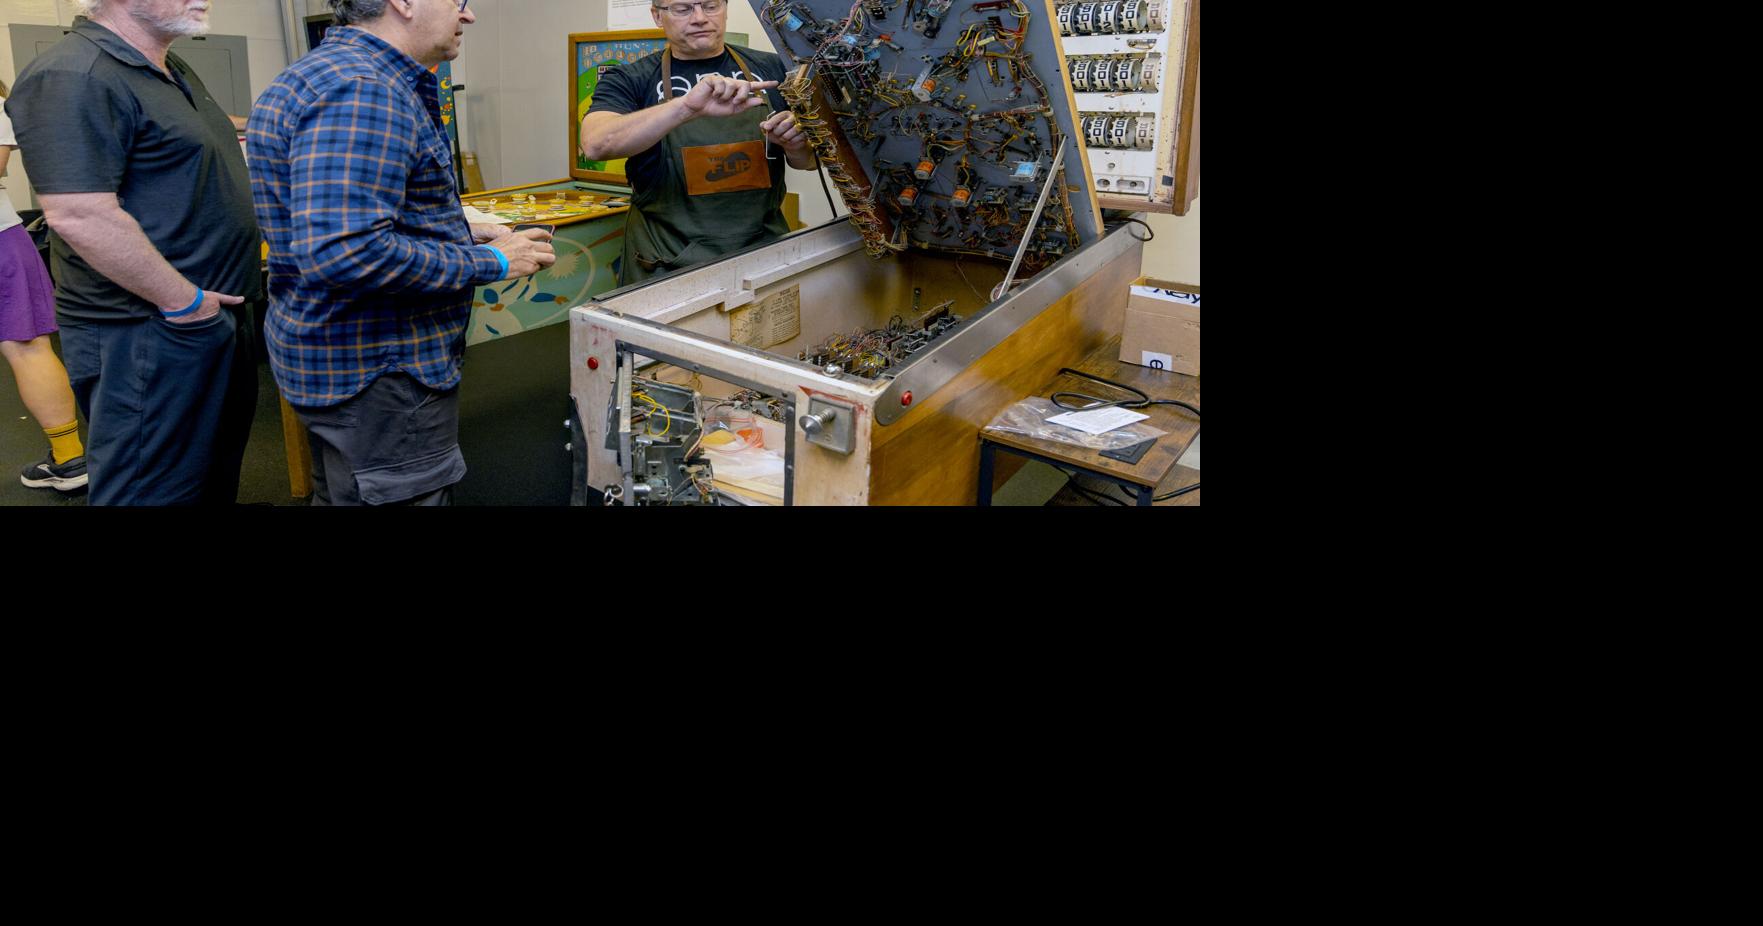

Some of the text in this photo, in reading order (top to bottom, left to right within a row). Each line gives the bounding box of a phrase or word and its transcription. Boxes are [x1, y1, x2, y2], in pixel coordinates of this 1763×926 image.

[1060, 15, 1068, 23] 0
[1081, 13, 1090, 22] 0
[1126, 10, 1134, 19] 0
[1077, 71, 1085, 79] 0
[1098, 71, 1106, 79] 0
[1120, 71, 1128, 79] 0
[1093, 128, 1101, 136] 0
[1115, 128, 1123, 136] 0
[711, 159, 752, 173] FLIP
